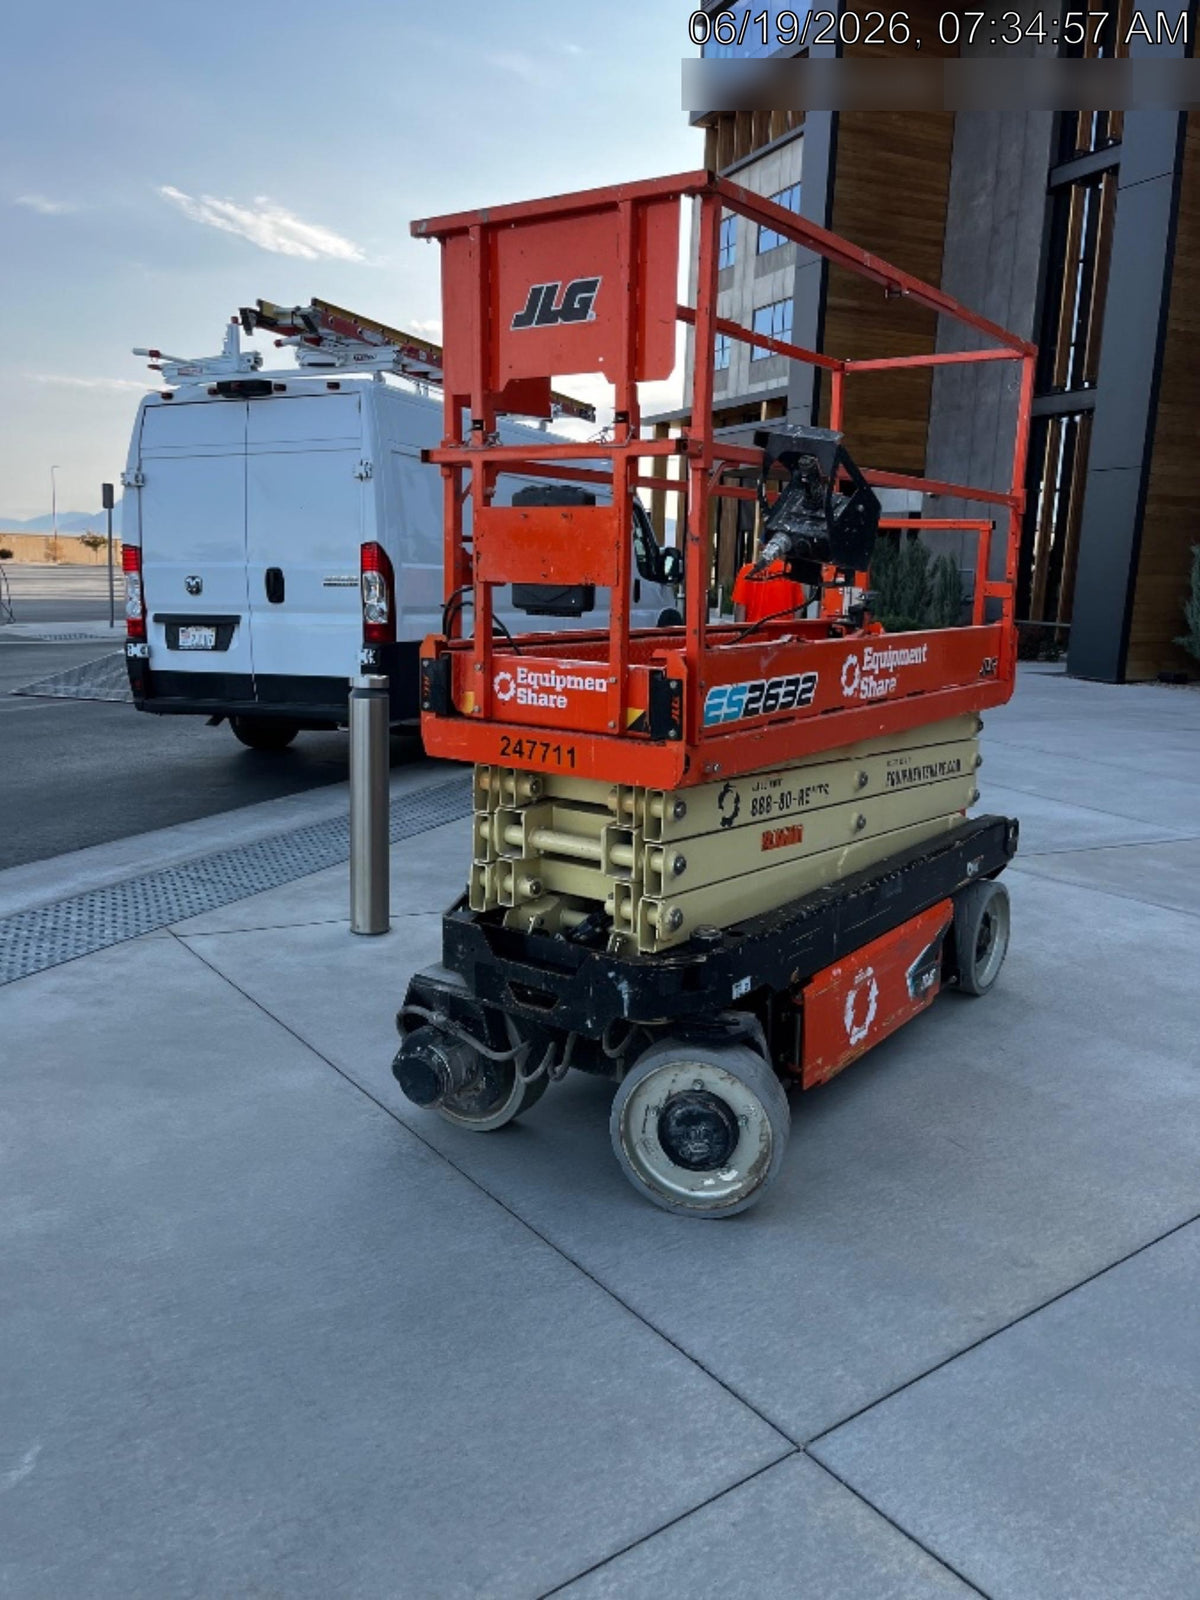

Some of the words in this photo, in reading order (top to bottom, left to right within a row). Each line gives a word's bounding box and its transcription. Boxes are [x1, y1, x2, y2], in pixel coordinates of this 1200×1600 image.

[510, 276, 602, 331] JLG
[862, 643, 928, 674] Equipment
[517, 667, 609, 692] Equipmen
[861, 675, 897, 699] Share
[517, 687, 568, 709] Share
[704, 672, 819, 727] ES2632
[501, 736, 576, 768] 247711
